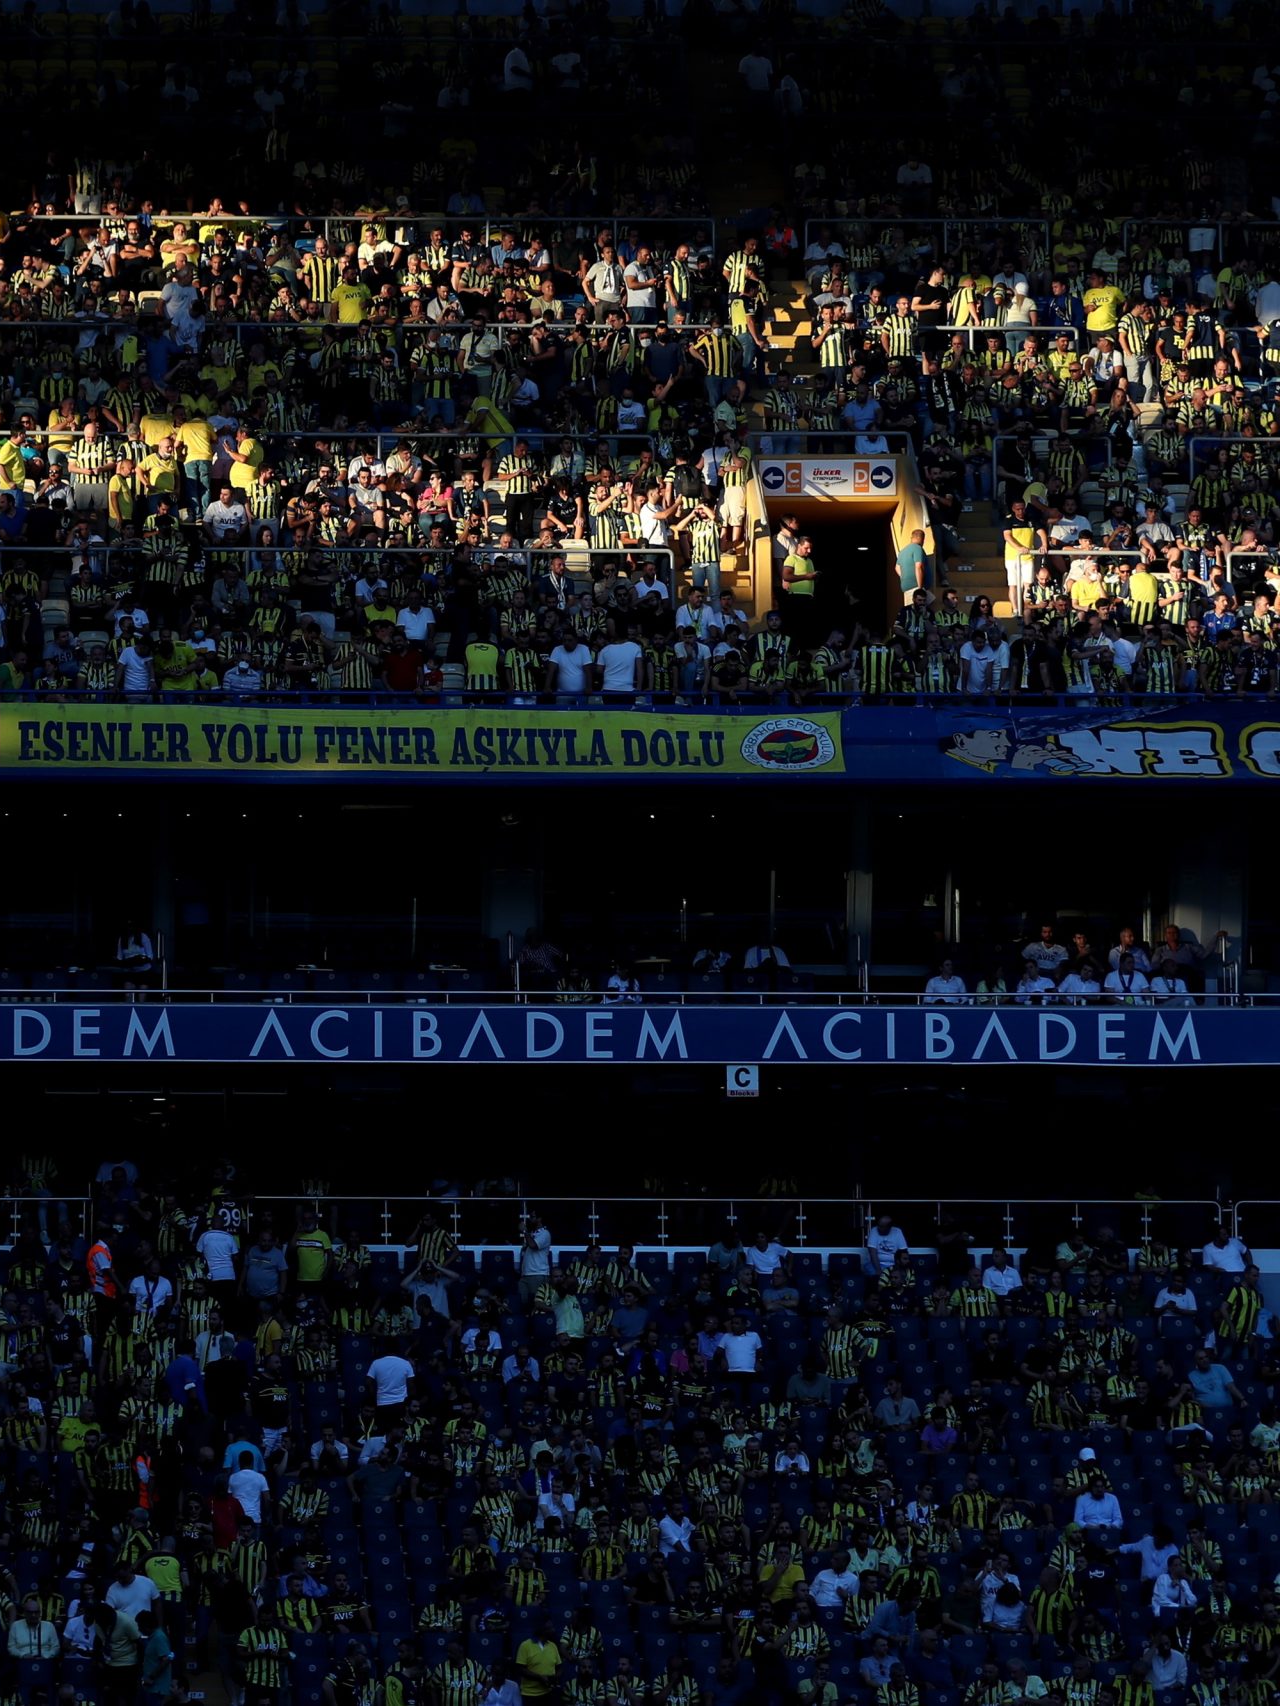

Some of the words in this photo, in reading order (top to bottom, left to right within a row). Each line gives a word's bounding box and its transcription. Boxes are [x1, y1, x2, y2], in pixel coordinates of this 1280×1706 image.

[344, 291, 362, 299] AVIS
[1091, 296, 1110, 305] AVIS
[787, 469, 800, 483] C
[813, 467, 841, 476] ÜLKER
[855, 469, 868, 483] D
[219, 517, 237, 525] AVIS
[115, 588, 132, 600] AVIS
[18, 720, 193, 762] ESENLER
[202, 723, 303, 764] YOLU
[315, 725, 440, 765] FENER
[450, 726, 612, 774] AŞKIYLA
[621, 729, 725, 767] DOLU
[247, 1010, 689, 1058] ACIBADEM
[762, 1011, 1204, 1060] ACIBADEM
[734, 1067, 751, 1088] C
[218, 1208, 241, 1228] 99
[966, 1295, 985, 1303] AVIS
[490, 1505, 509, 1517] AVIS
[334, 1612, 354, 1621] AVIS
[450, 1680, 471, 1688] AVIS
